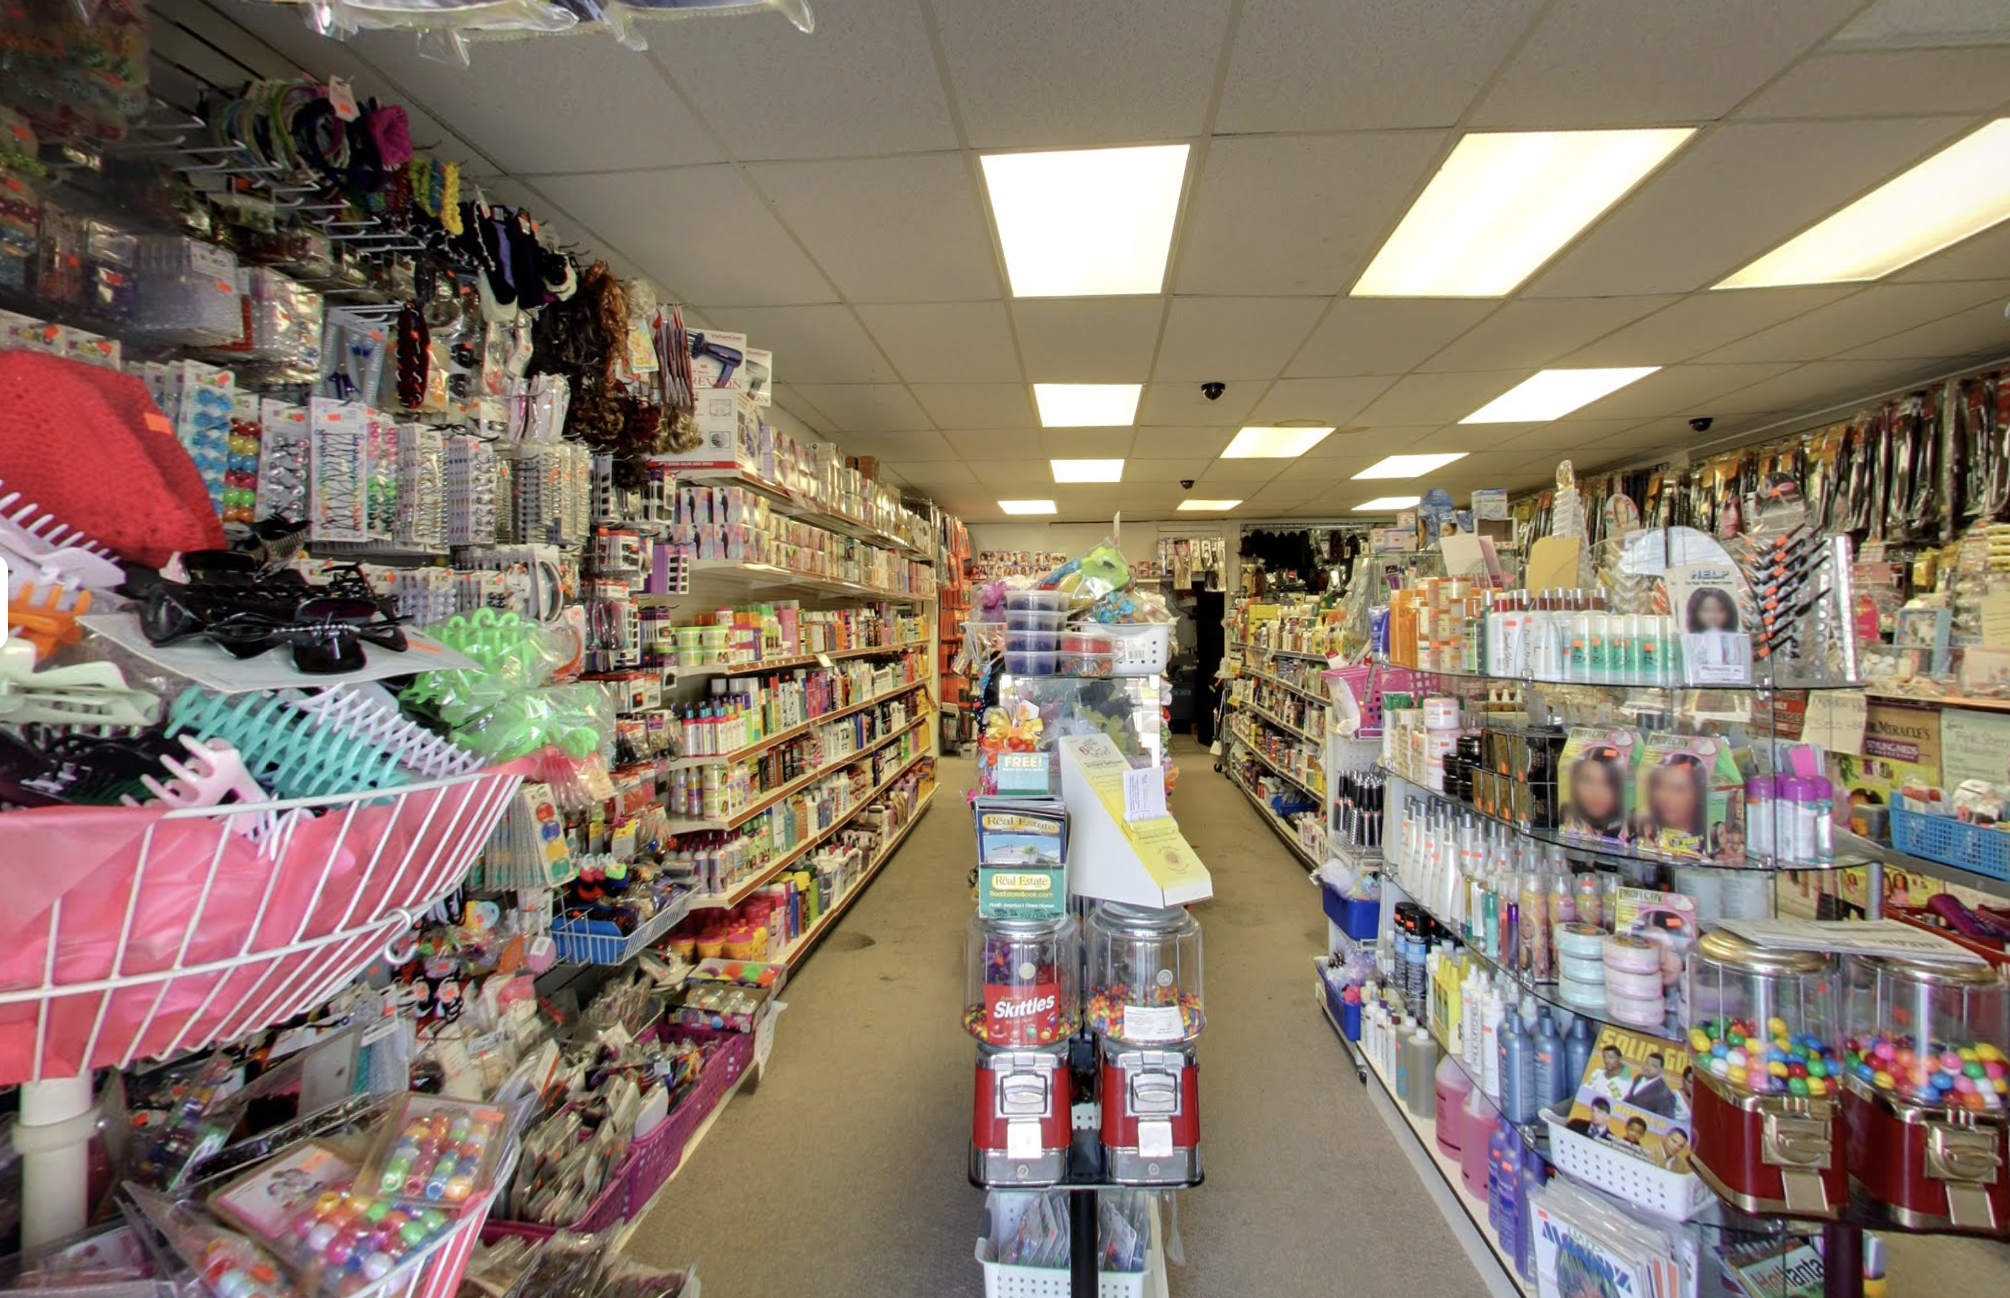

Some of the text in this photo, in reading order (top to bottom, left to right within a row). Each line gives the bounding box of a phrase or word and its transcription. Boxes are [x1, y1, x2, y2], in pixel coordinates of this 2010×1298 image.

[692, 376, 742, 389] REVON
[1690, 569, 1730, 580] HELP
[1004, 755, 1042, 768] FREE!
[987, 815, 1055, 831] Real Estate
[995, 875, 1048, 886] Real Estate
[993, 994, 1055, 1019] Skittles
